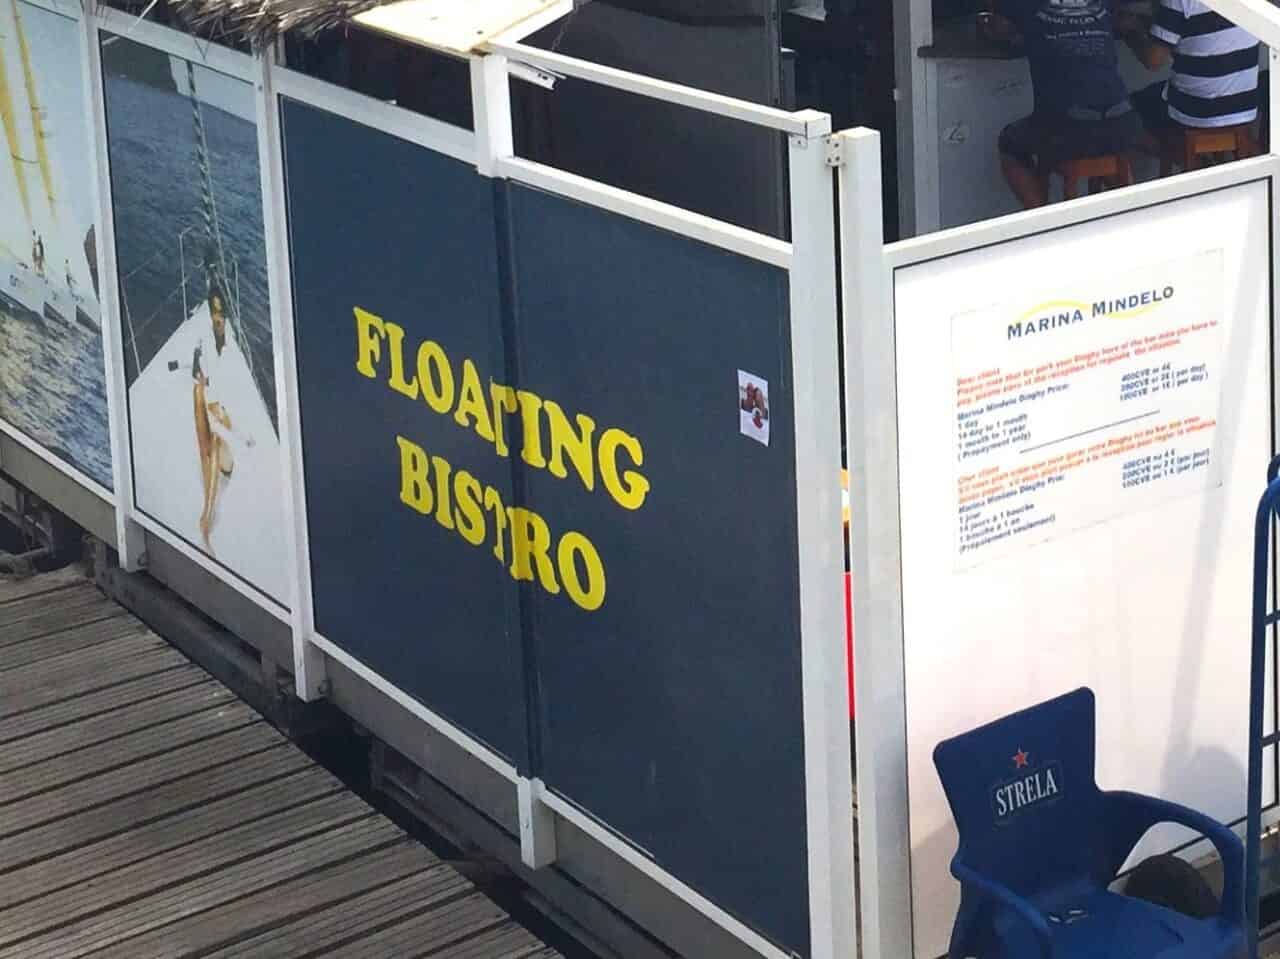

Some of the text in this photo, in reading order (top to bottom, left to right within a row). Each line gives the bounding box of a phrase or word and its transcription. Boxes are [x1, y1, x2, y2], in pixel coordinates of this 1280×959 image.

[1007, 286, 1174, 340] MARINA MINDELO
[353, 306, 650, 510] FLOATING
[957, 406, 983, 420] Marina
[985, 396, 1016, 412] Mindelo
[1018, 387, 1045, 404] Dinghy
[396, 435, 606, 610] BISTRO
[995, 768, 1058, 817] STRELA
